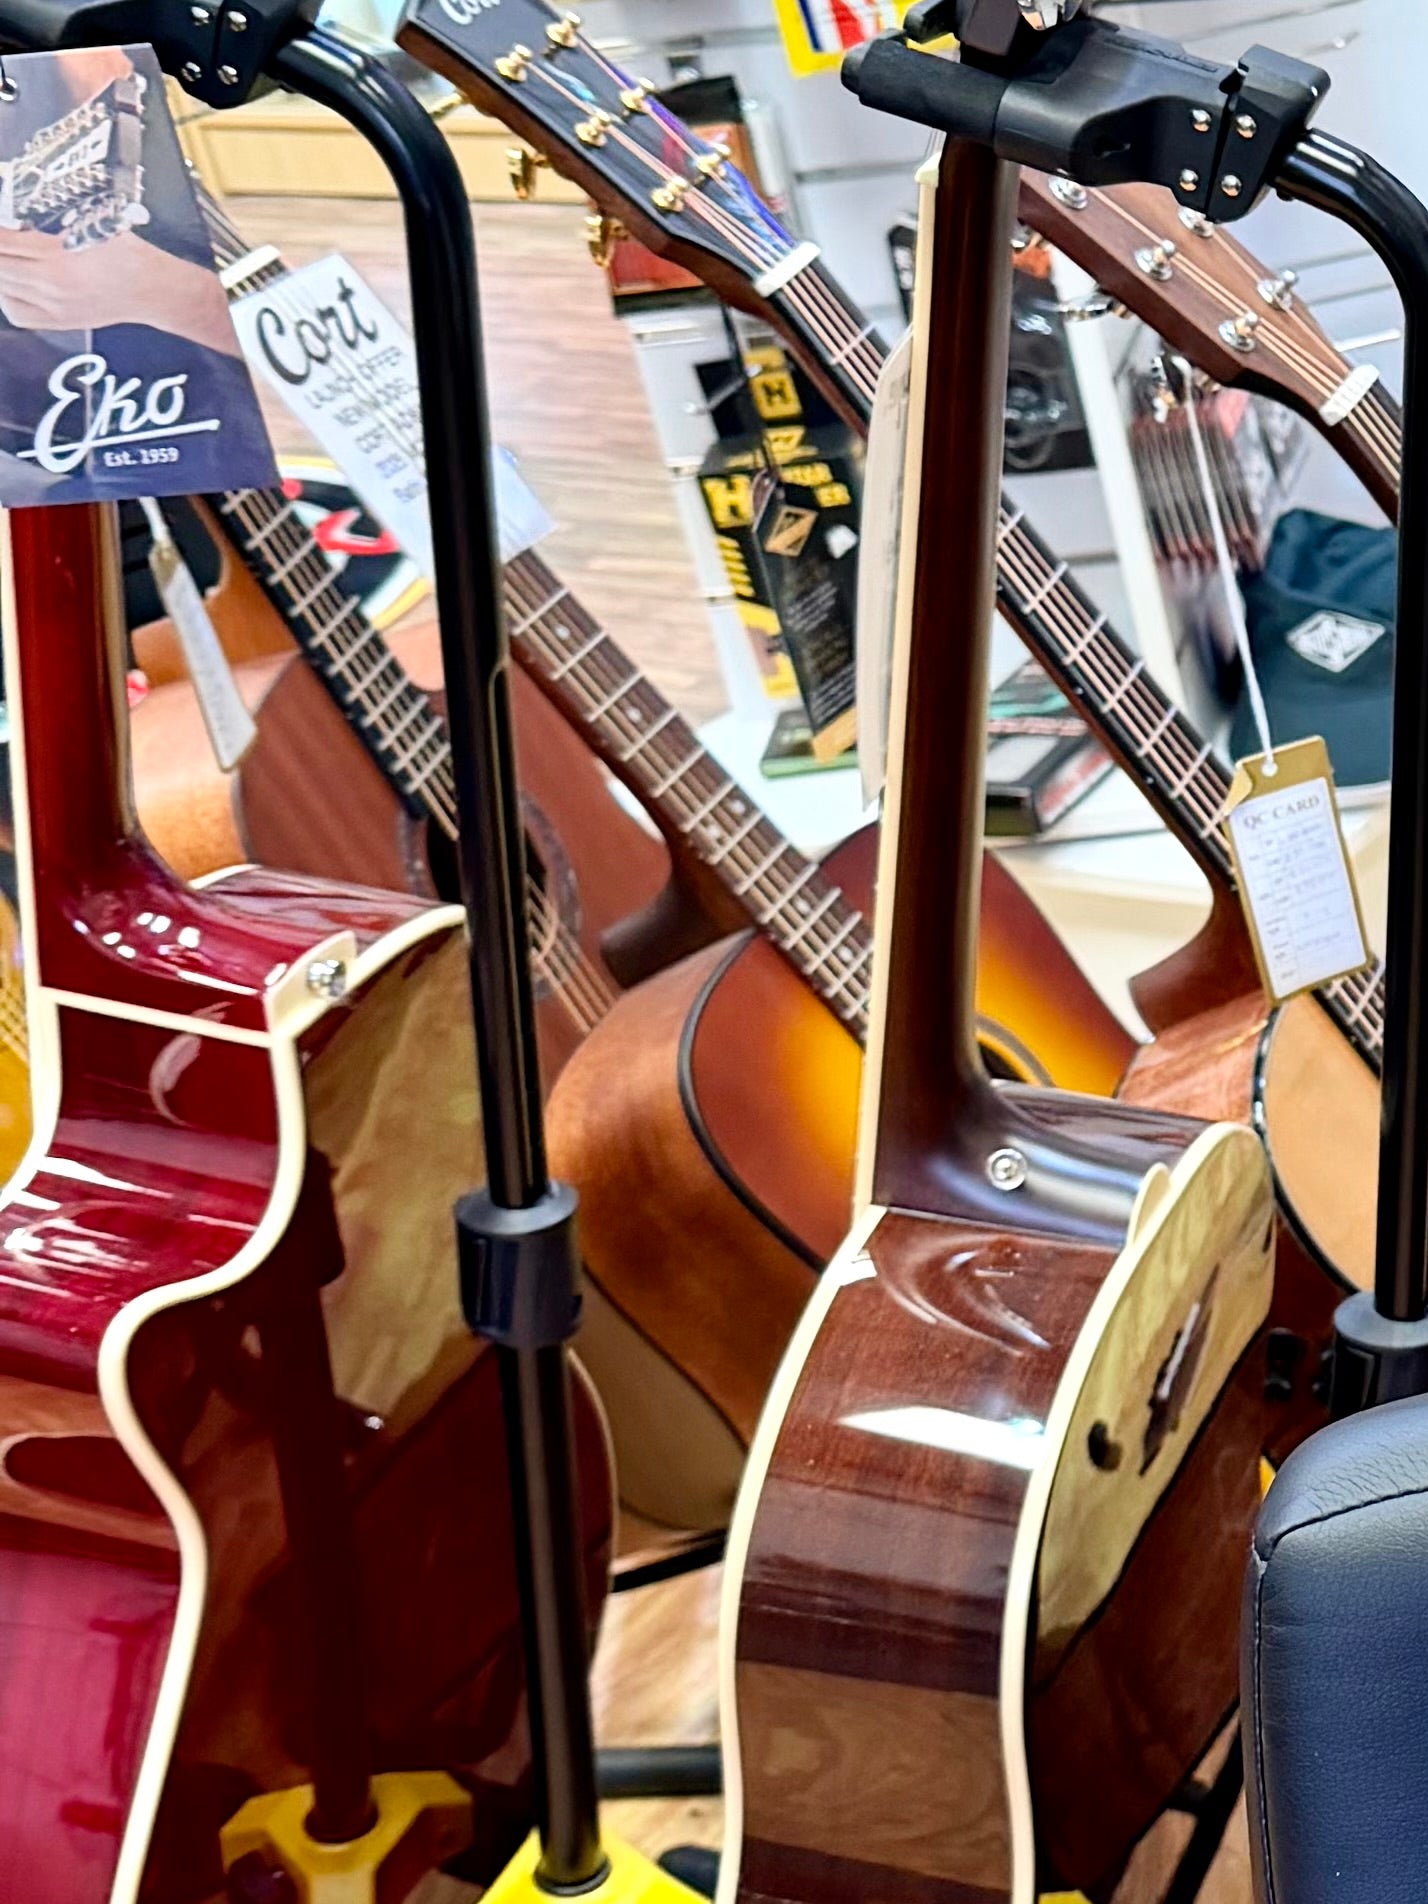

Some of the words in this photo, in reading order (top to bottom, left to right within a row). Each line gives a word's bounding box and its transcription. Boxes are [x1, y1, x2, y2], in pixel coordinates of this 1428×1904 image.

[257, 277, 378, 386] Cort
[33, 353, 188, 474] Eko
[104, 447, 135, 468] Est.
[140, 444, 180, 466] 1959
[1243, 809, 1269, 831] QC
[1271, 794, 1321, 820] CARD
